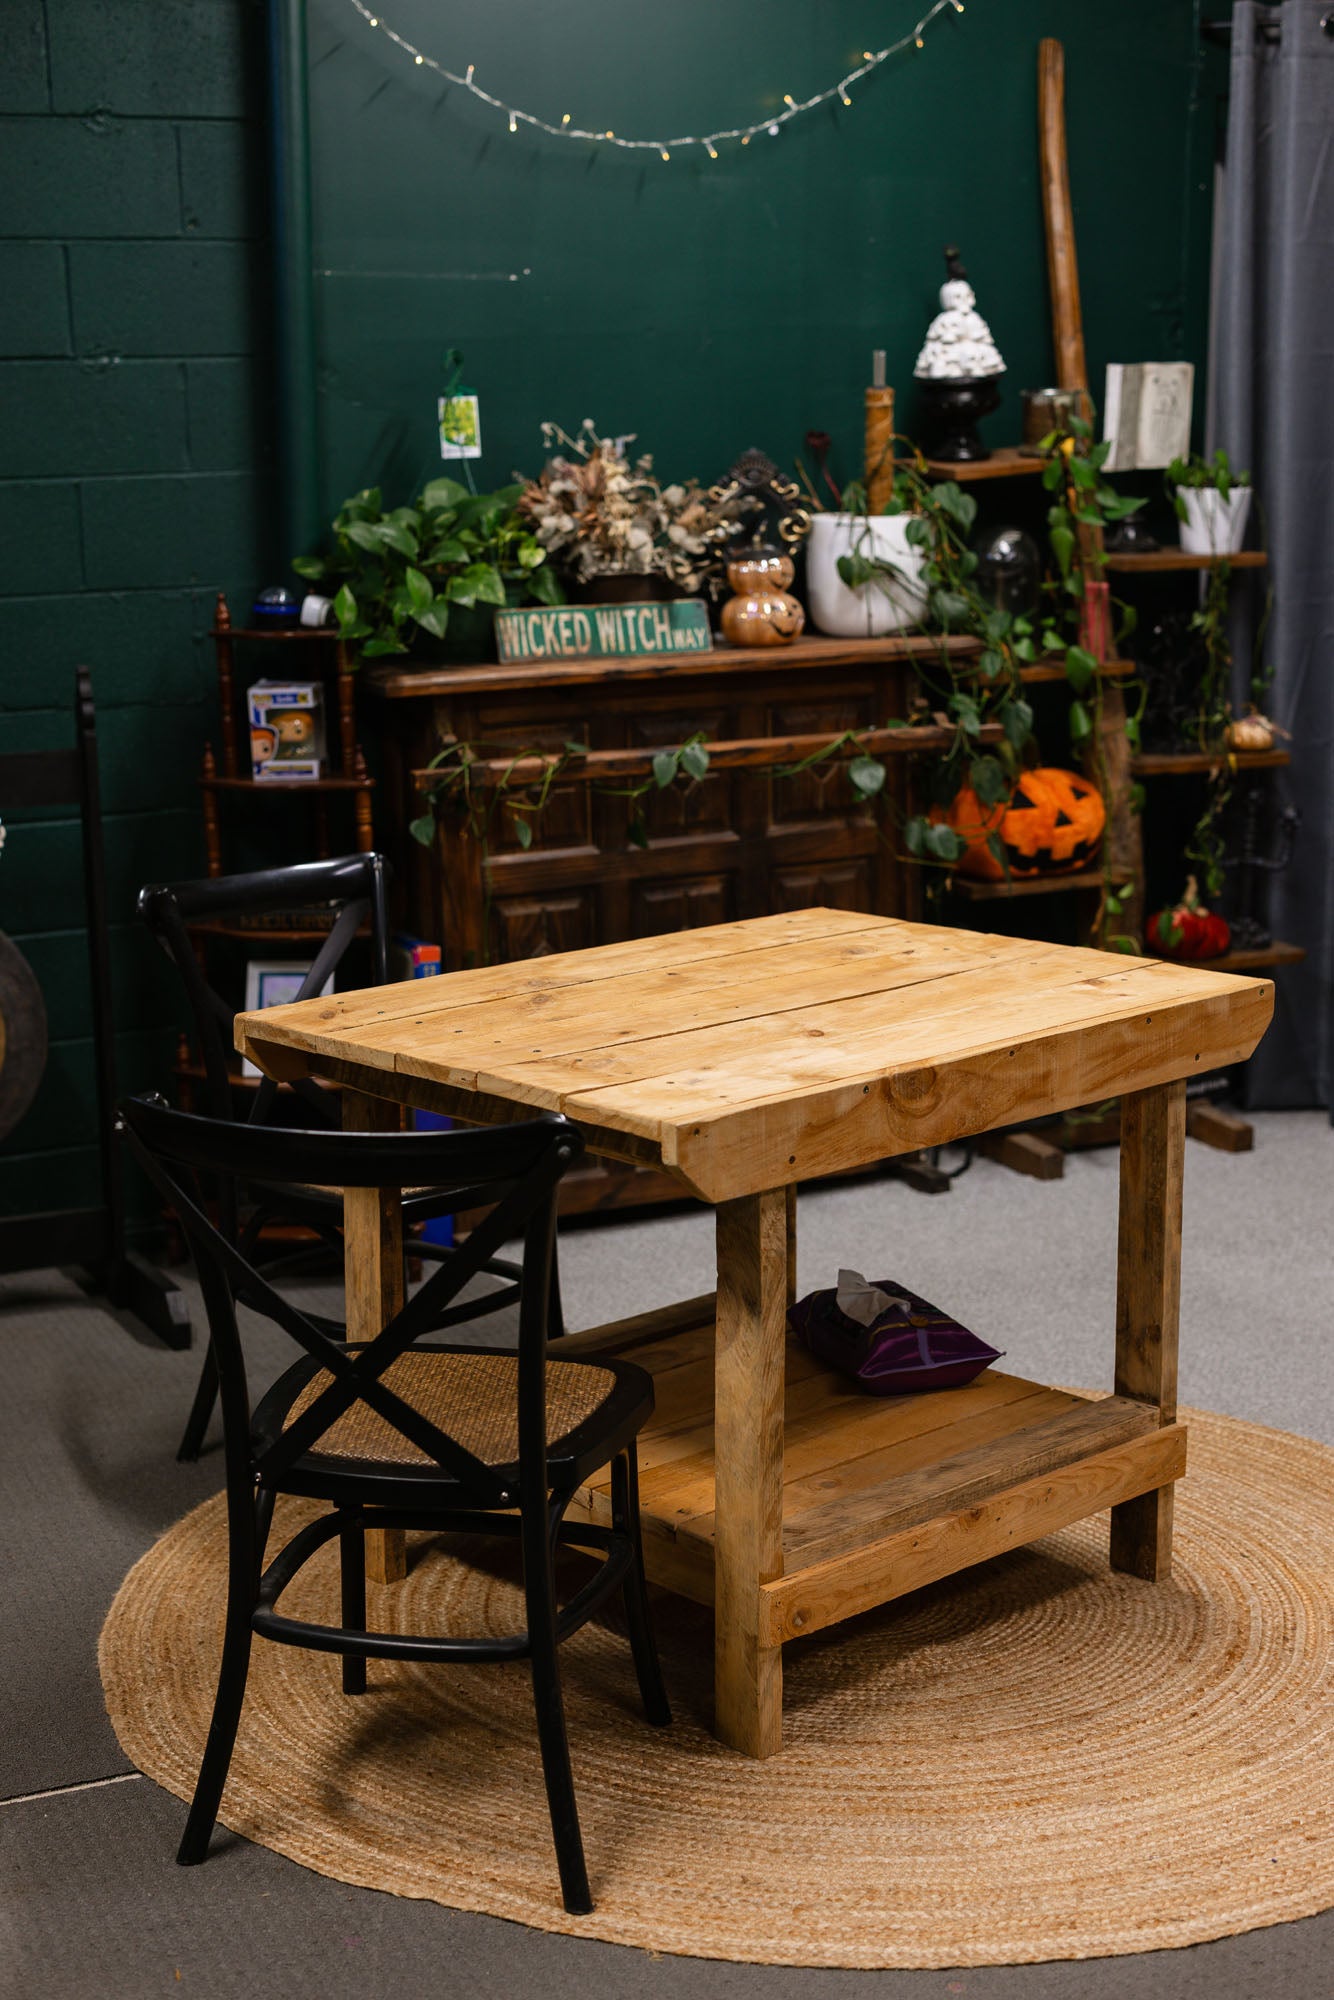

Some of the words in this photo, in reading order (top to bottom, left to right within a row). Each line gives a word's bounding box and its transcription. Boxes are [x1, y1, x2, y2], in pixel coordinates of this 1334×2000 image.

[500, 612, 592, 657] WICKED
[595, 607, 673, 653] WITCH
[672, 627, 707, 649] WAY
